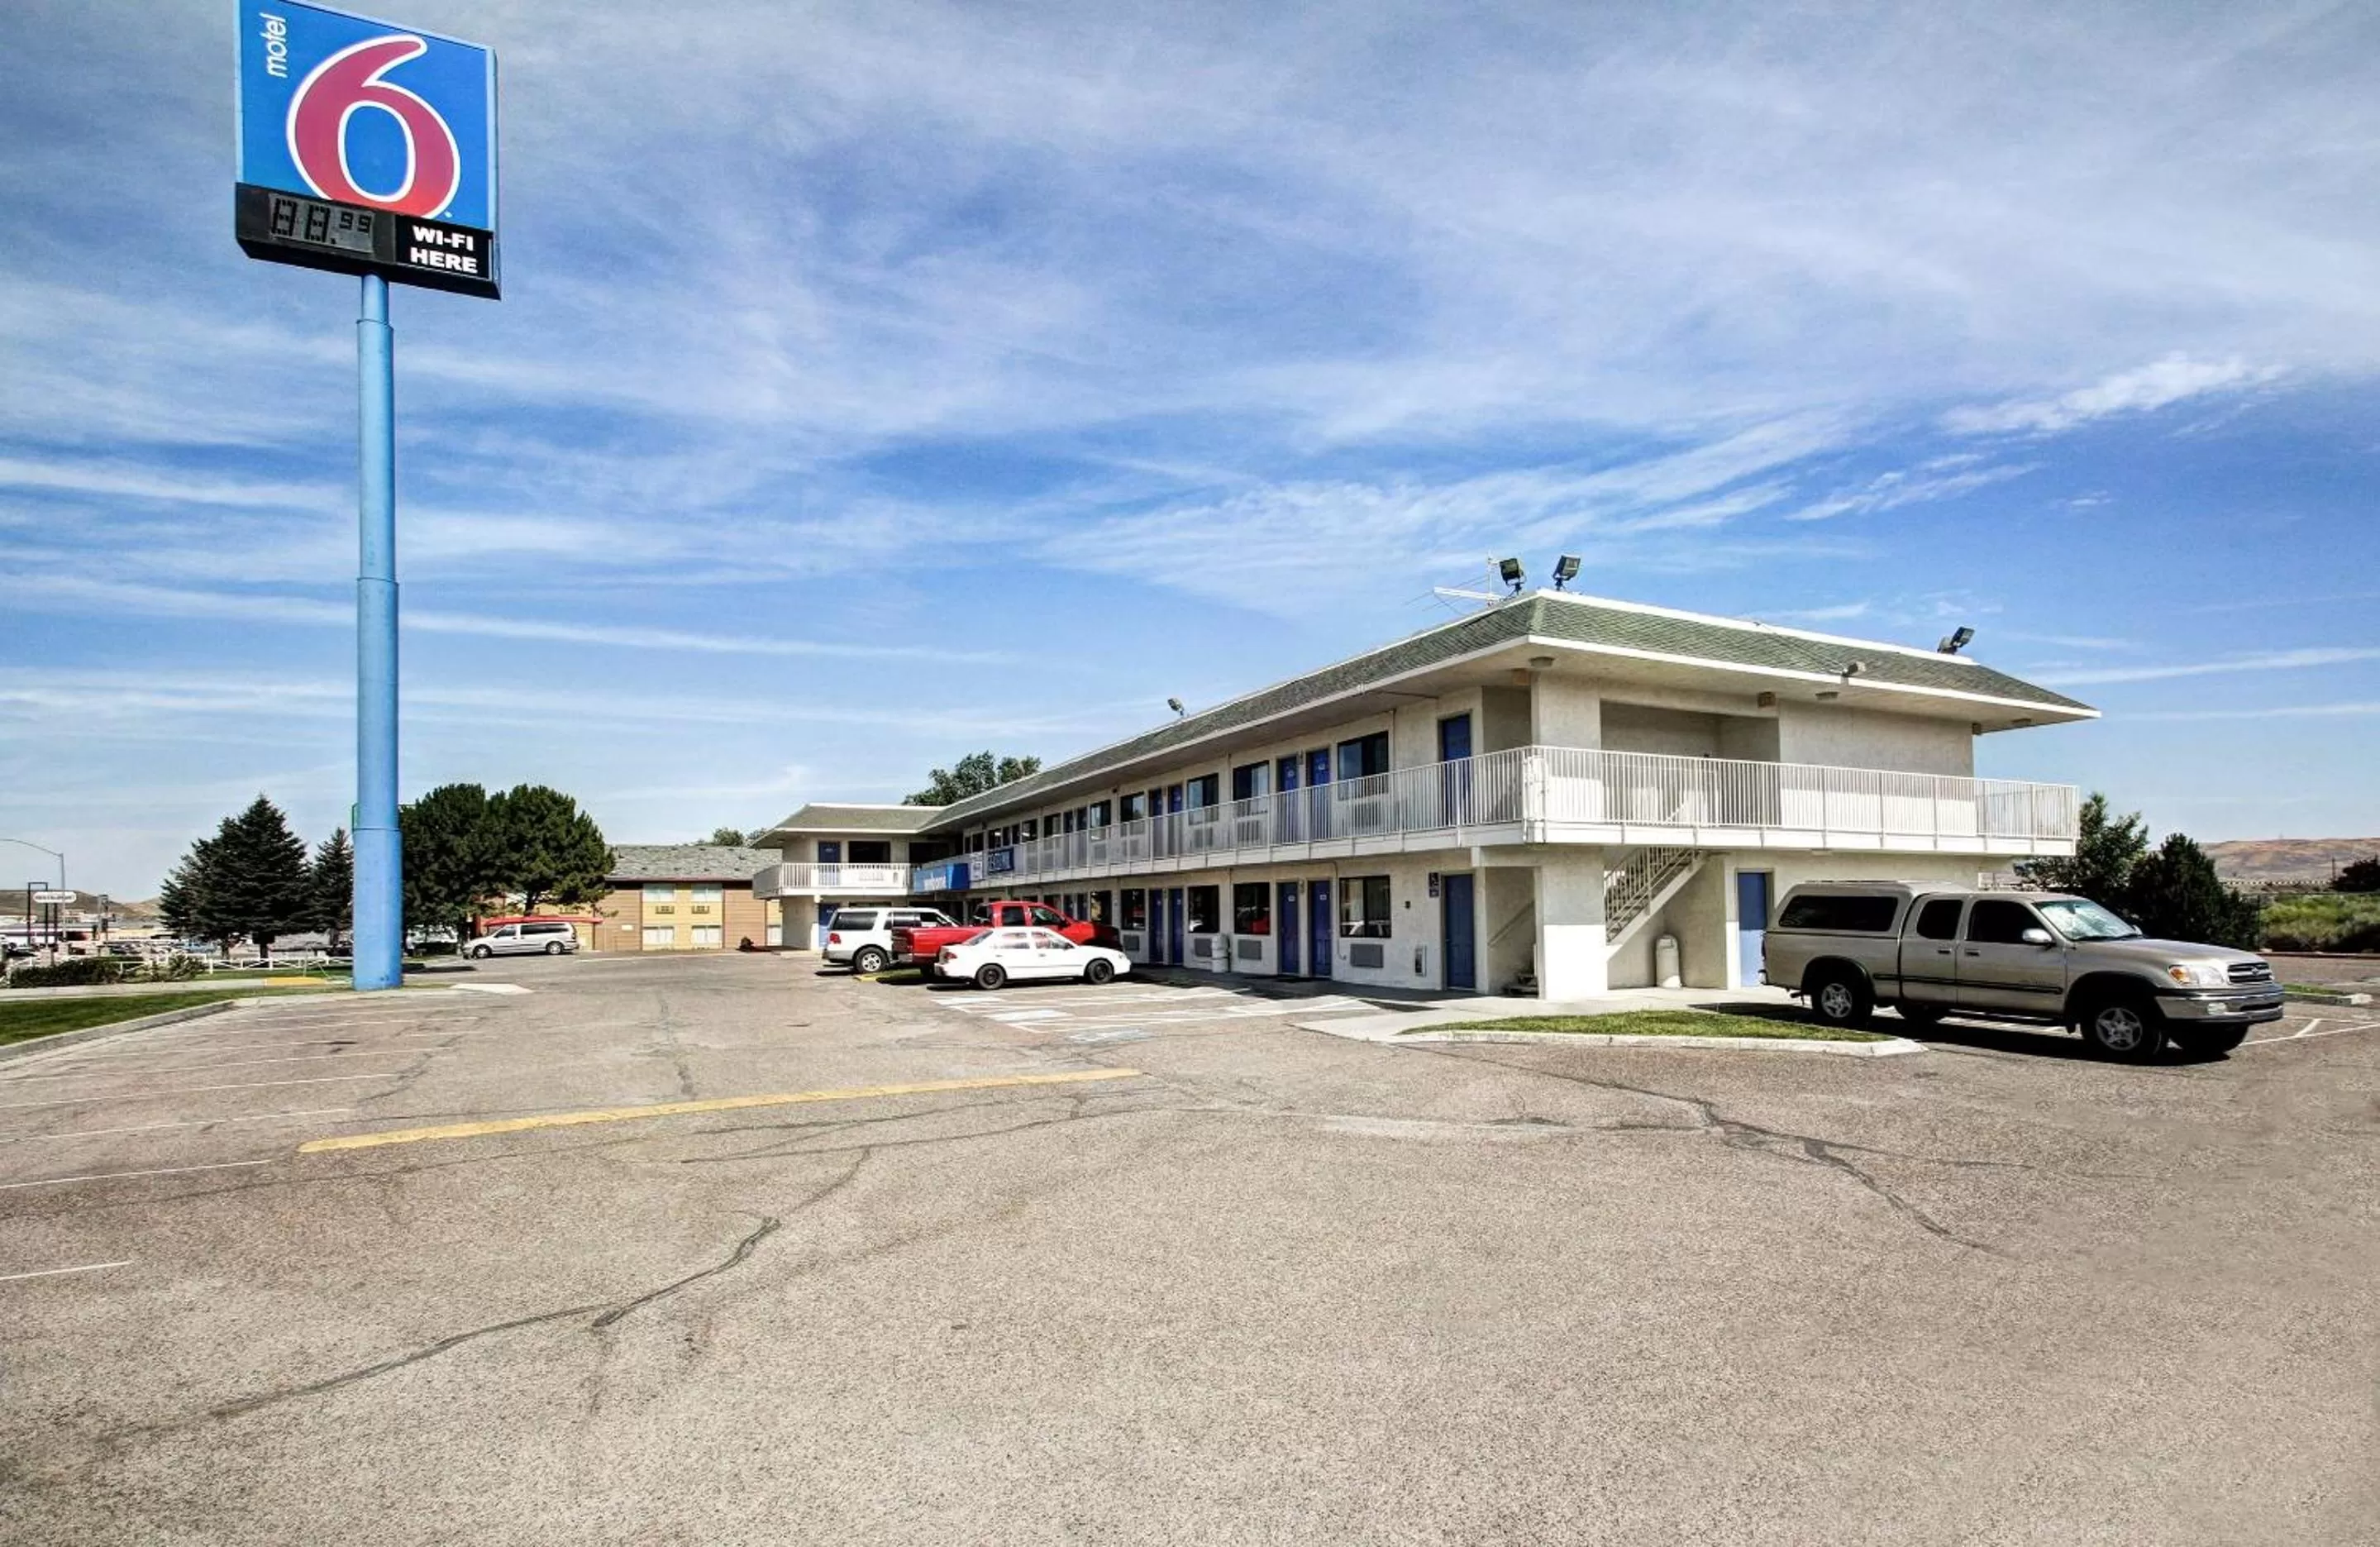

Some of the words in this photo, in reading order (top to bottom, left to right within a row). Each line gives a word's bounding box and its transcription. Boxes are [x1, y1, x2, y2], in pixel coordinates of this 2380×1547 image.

[259, 12, 288, 79] motel
[286, 33, 460, 218] 6
[410, 247, 478, 274] HERE
[413, 225, 474, 251] WI-FI
